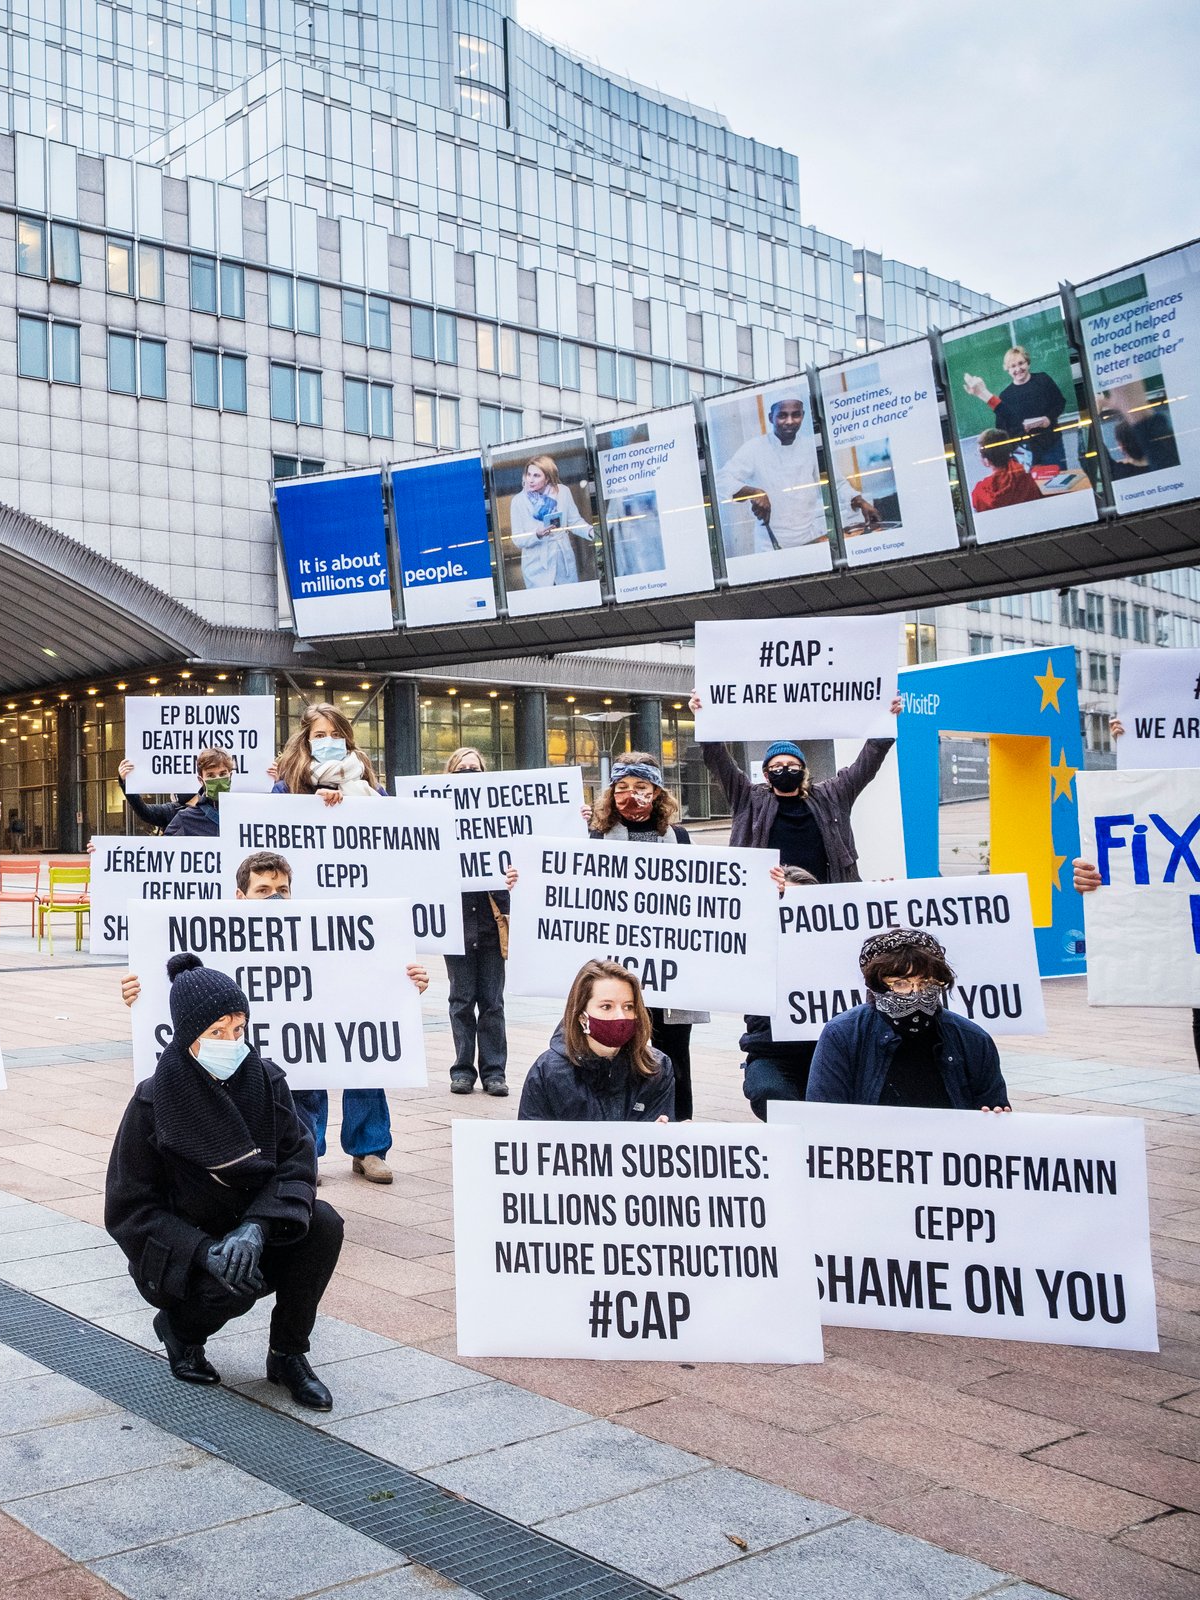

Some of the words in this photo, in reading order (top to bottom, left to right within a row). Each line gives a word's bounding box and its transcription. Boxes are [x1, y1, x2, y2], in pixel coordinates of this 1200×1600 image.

[1113, 292, 1183, 323] experiences
[1090, 322, 1132, 347] abroad
[1135, 308, 1176, 332] helped
[1093, 347, 1111, 361] me
[1113, 333, 1159, 354] become
[1162, 329, 1170, 339] a
[1096, 357, 1130, 376] better
[831, 412, 849, 425] you
[851, 406, 870, 420] just
[872, 396, 898, 412] need
[901, 394, 911, 405] to
[914, 390, 928, 401] be
[833, 422, 860, 438] given
[862, 419, 869, 428] a
[605, 463, 629, 474] when
[631, 459, 645, 469] my
[646, 453, 668, 465] child
[612, 452, 627, 461] am
[628, 439, 675, 458] concerned
[606, 475, 627, 488] goes
[1124, 490, 1145, 500] count
[1157, 482, 1184, 493] Europe
[299, 559, 311, 574] It
[314, 557, 328, 573] is
[331, 552, 381, 571] about
[855, 547, 872, 555] count
[882, 541, 905, 550] Europe
[300, 574, 365, 593] millions
[368, 569, 387, 586] of
[404, 560, 468, 587] people.
[759, 639, 821, 668] #CAP
[709, 684, 737, 705] WE
[742, 683, 778, 704] ARE
[783, 676, 882, 703] WATCHING!
[160, 705, 181, 726] EP
[184, 704, 240, 725] BLOWS
[1134, 717, 1167, 739] WE
[1172, 717, 1200, 739] AR
[142, 730, 193, 750] DEATH
[198, 730, 234, 749] KISS
[238, 729, 258, 750] TO
[486, 781, 570, 809] DECERLE
[239, 823, 327, 850] HERBERT
[332, 825, 441, 851] DORFMANN
[103, 845, 176, 873] JÉRÉMY
[541, 850, 567, 875] EU
[572, 852, 629, 879] FARM
[634, 856, 747, 887] SUBSIDIES:
[316, 863, 369, 888] (EPP)
[545, 885, 629, 913] BILLIONS
[634, 891, 691, 917] GOING
[697, 895, 741, 921] INTO
[778, 902, 860, 934] PAOLO
[866, 900, 898, 930] DE
[907, 894, 1011, 928] CASTRO
[168, 915, 302, 953] NORBERT
[310, 914, 375, 952] LINS
[411, 903, 447, 938] OU
[537, 917, 610, 945] NATURE
[615, 923, 747, 955] DESTRUCTION
[235, 965, 313, 1002] (EPP)
[957, 983, 1023, 1020] YOU
[281, 1022, 327, 1065] ON
[334, 1021, 402, 1063] YOU
[494, 1141, 528, 1176] EU
[537, 1142, 613, 1177] FARM
[621, 1143, 769, 1180] SUBSIDIES:
[942, 1151, 1117, 1196] DORFMANN
[502, 1192, 617, 1227] BILLIONS
[624, 1194, 701, 1228] GOING
[708, 1195, 766, 1229] INTO
[914, 1205, 996, 1244] (EPP)
[495, 1241, 596, 1275] NATURE
[603, 1243, 779, 1279] DESTRUCTION
[964, 1263, 1025, 1317] ON
[1034, 1268, 1127, 1325] YOU
[588, 1290, 691, 1340] #CAP
